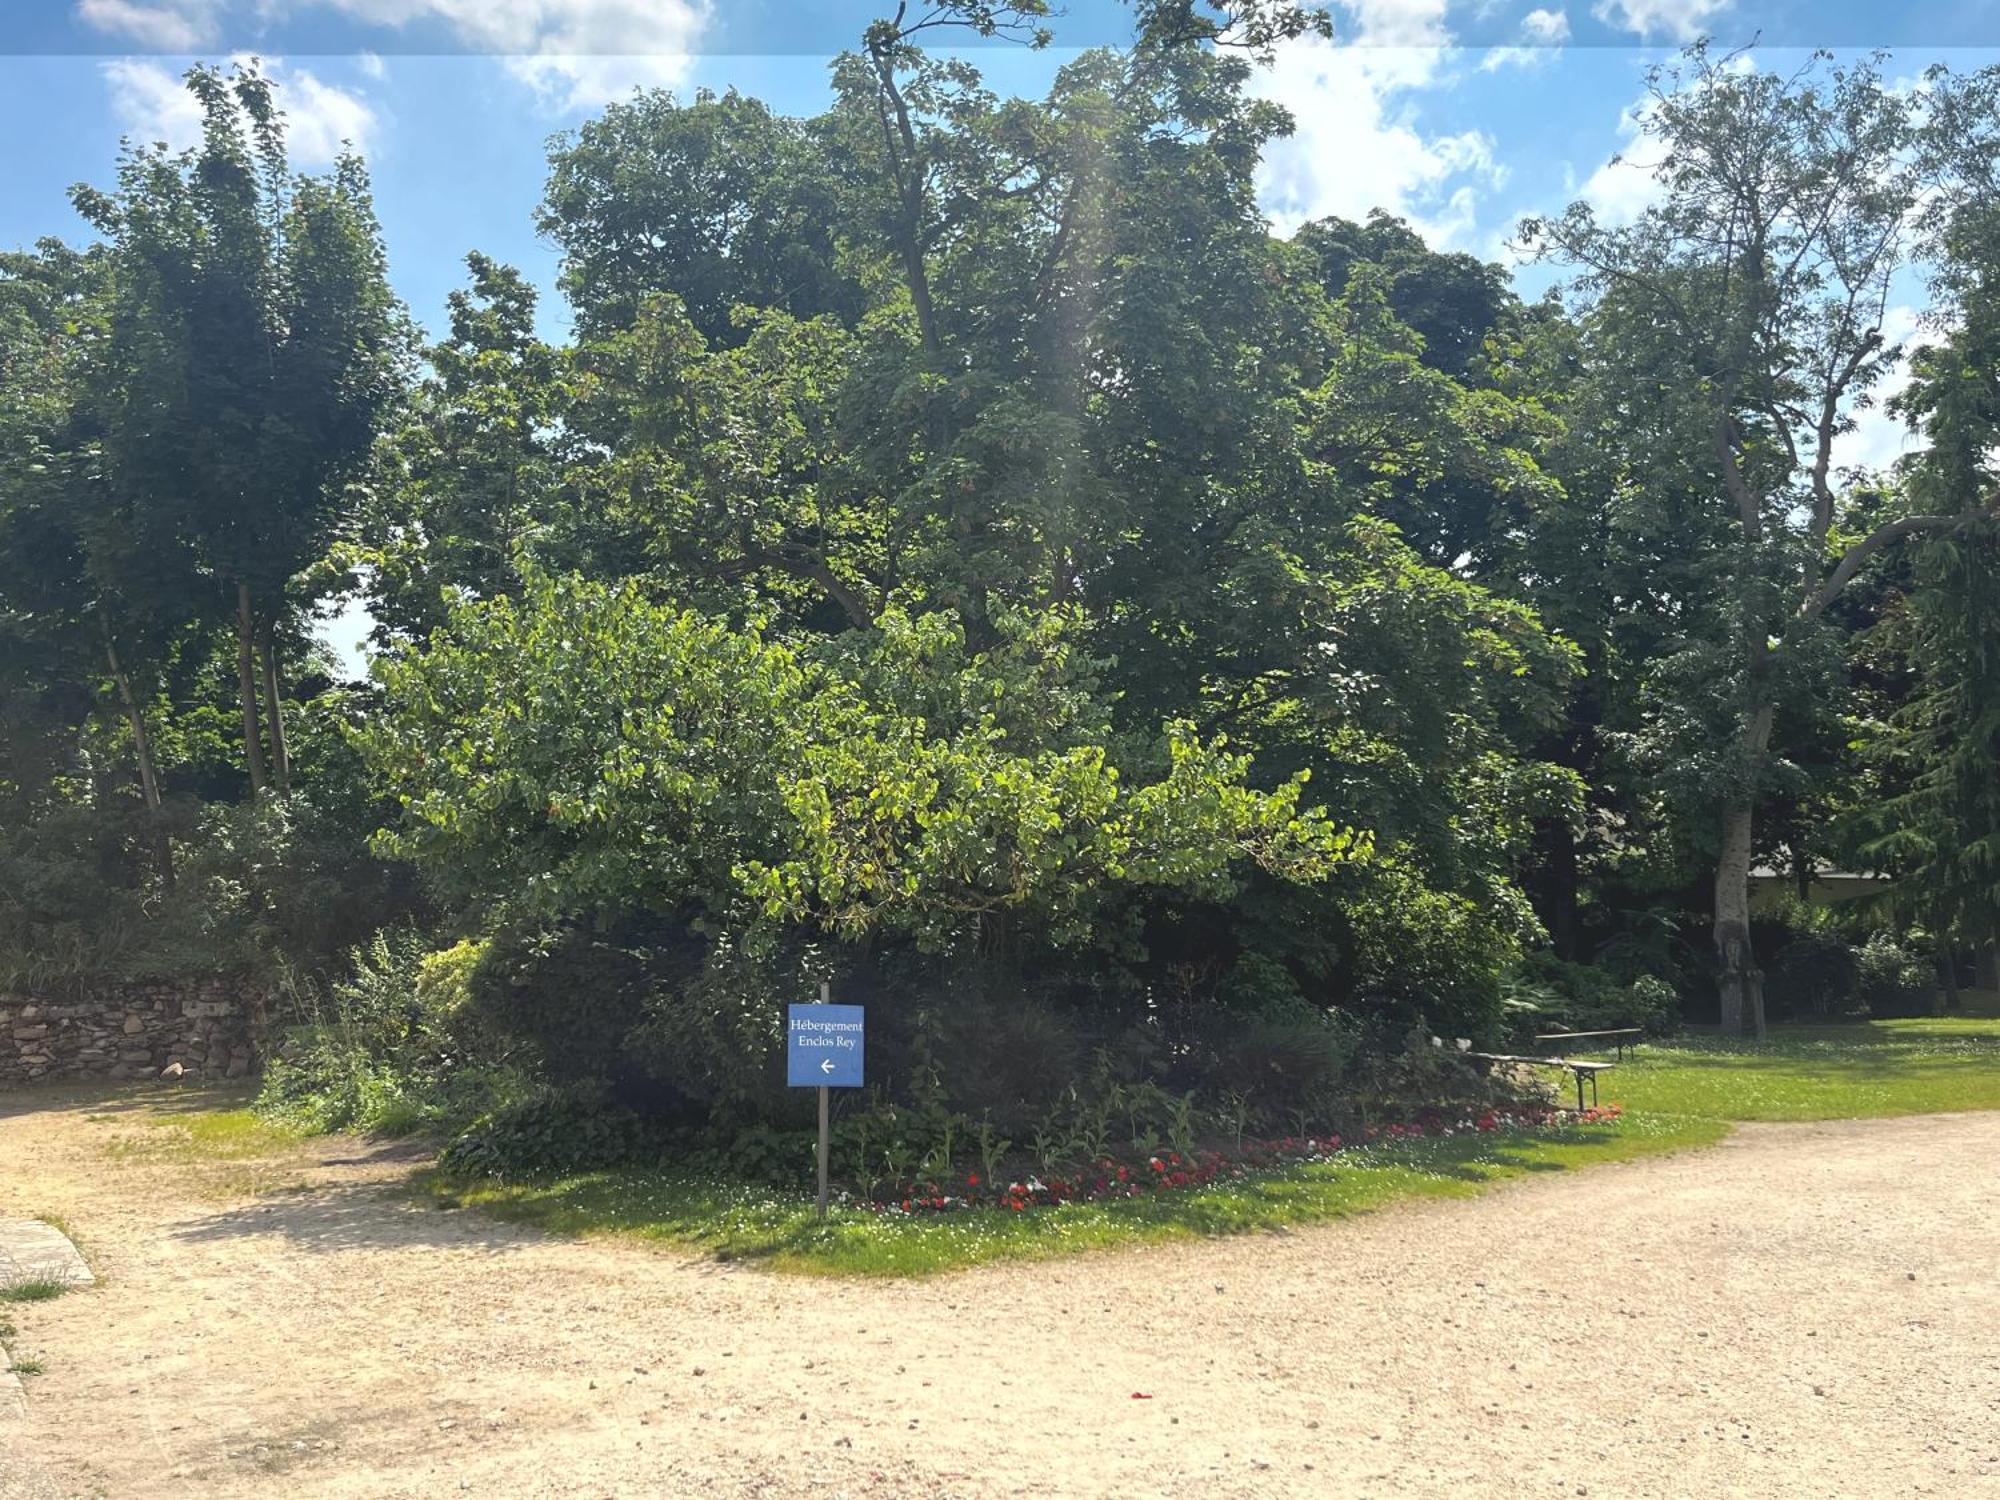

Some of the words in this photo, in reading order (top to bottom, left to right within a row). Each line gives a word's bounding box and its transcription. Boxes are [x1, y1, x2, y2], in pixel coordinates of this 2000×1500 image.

[790, 1019, 863, 1033] Hébergement
[798, 1035, 834, 1047] Enclos
[836, 1035, 856, 1050] Rey
